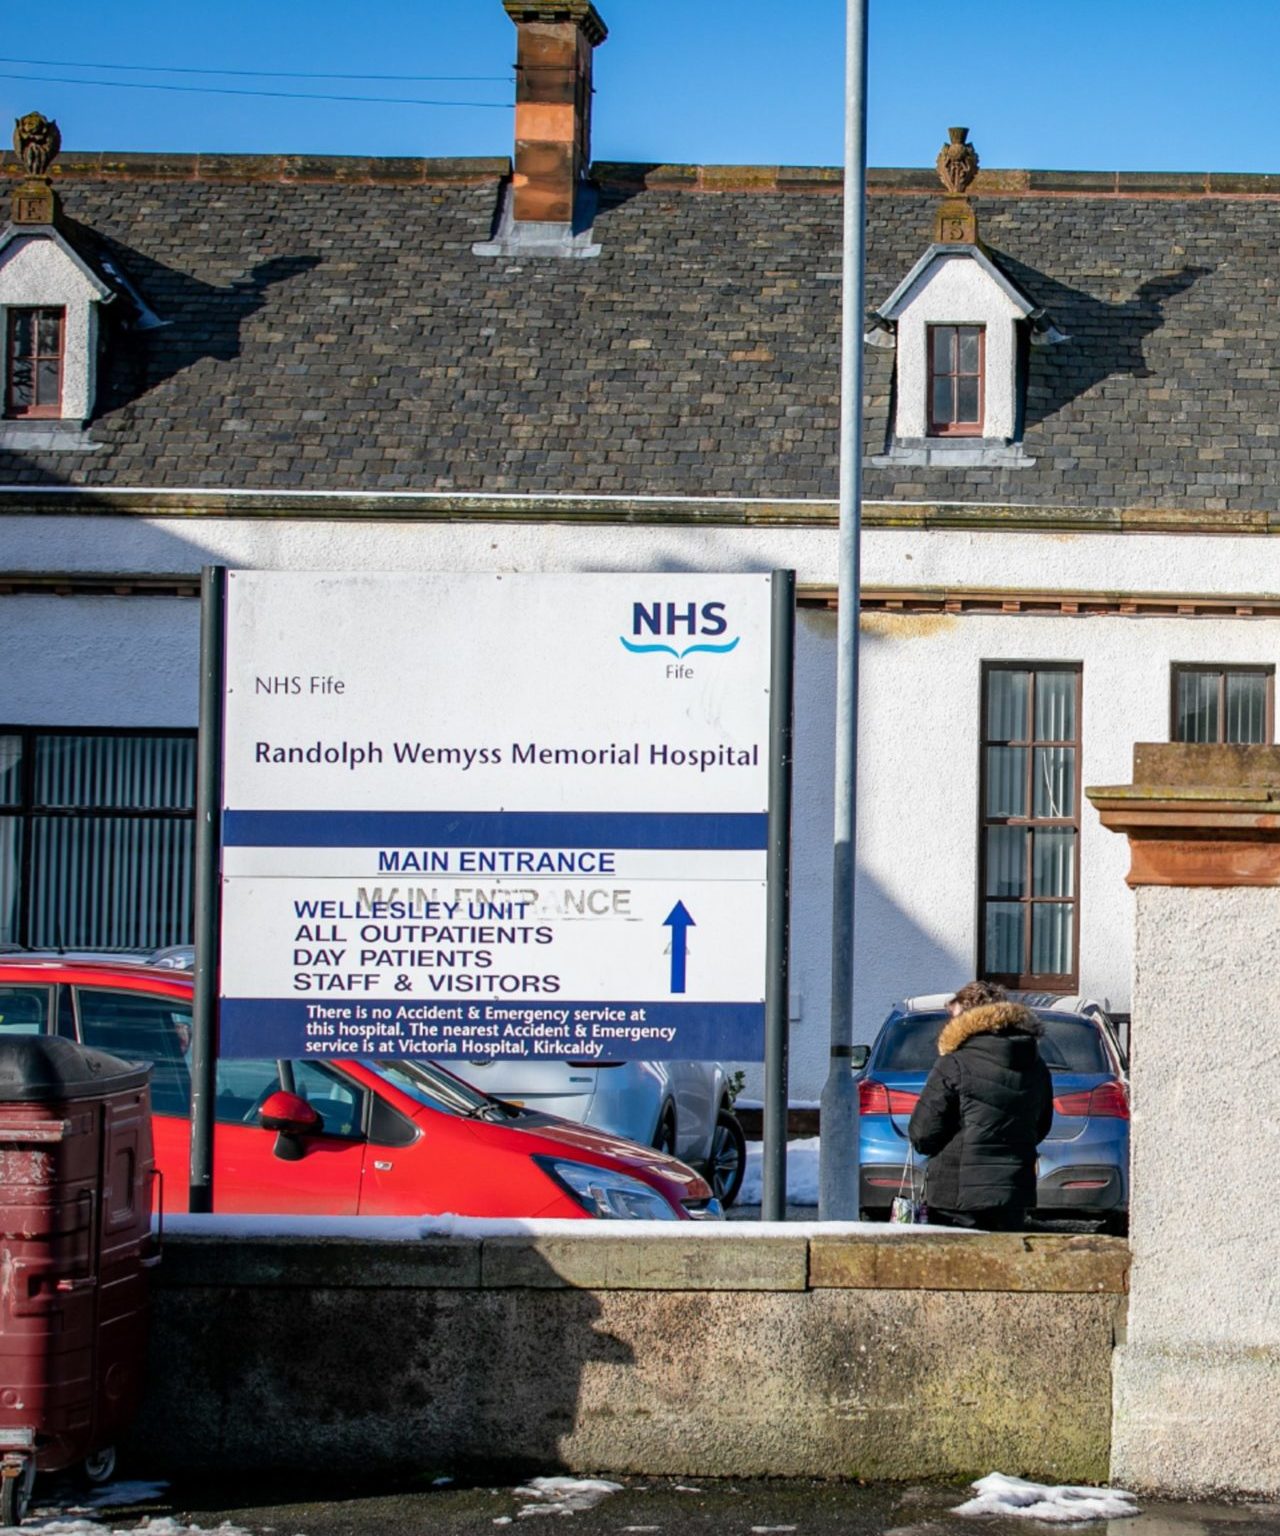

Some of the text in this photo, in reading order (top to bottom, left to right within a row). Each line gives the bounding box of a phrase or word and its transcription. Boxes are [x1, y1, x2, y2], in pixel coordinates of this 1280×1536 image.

[632, 601, 728, 636] NHS
[665, 664, 694, 680] Fife
[255, 675, 345, 695] NHS Fife
[255, 741, 759, 773] Randolph Wemyss Memorial Hospital
[378, 851, 616, 873] MAIN ENTRANCE
[294, 900, 530, 920] WELLESLEY UNIT
[454, 888, 632, 915] ENRNCE
[294, 924, 553, 944] ALL OUTPATIENTS
[293, 948, 493, 968] DAY PATIENTS
[293, 972, 561, 993] STAFF & VISITORS
[306, 1004, 646, 1024] There is no Accident & Emergency service at
[306, 1021, 676, 1041] this hospital. The nearest Accident & Emergency
[305, 1038, 603, 1058] service is at Victoria Hospital, Kirkcaldy
